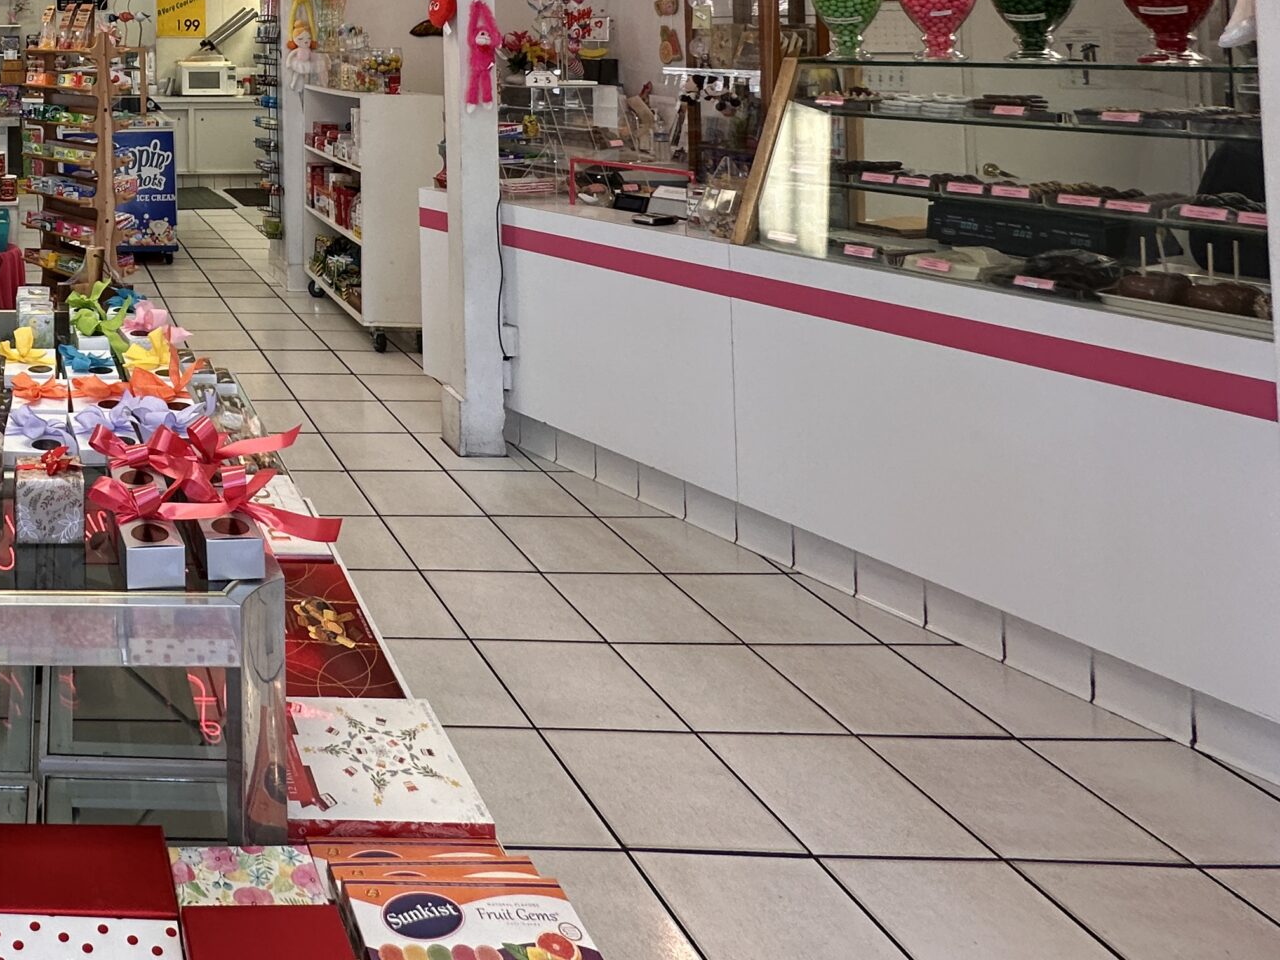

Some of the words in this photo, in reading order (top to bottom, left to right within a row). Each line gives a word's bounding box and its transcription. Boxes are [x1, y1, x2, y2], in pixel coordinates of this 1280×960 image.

[136, 194, 150, 202] ICE
[151, 194, 177, 202] CREAM
[386, 900, 460, 930] Sunkist
[476, 907, 514, 921] Fruit
[516, 907, 559, 922] Gems
